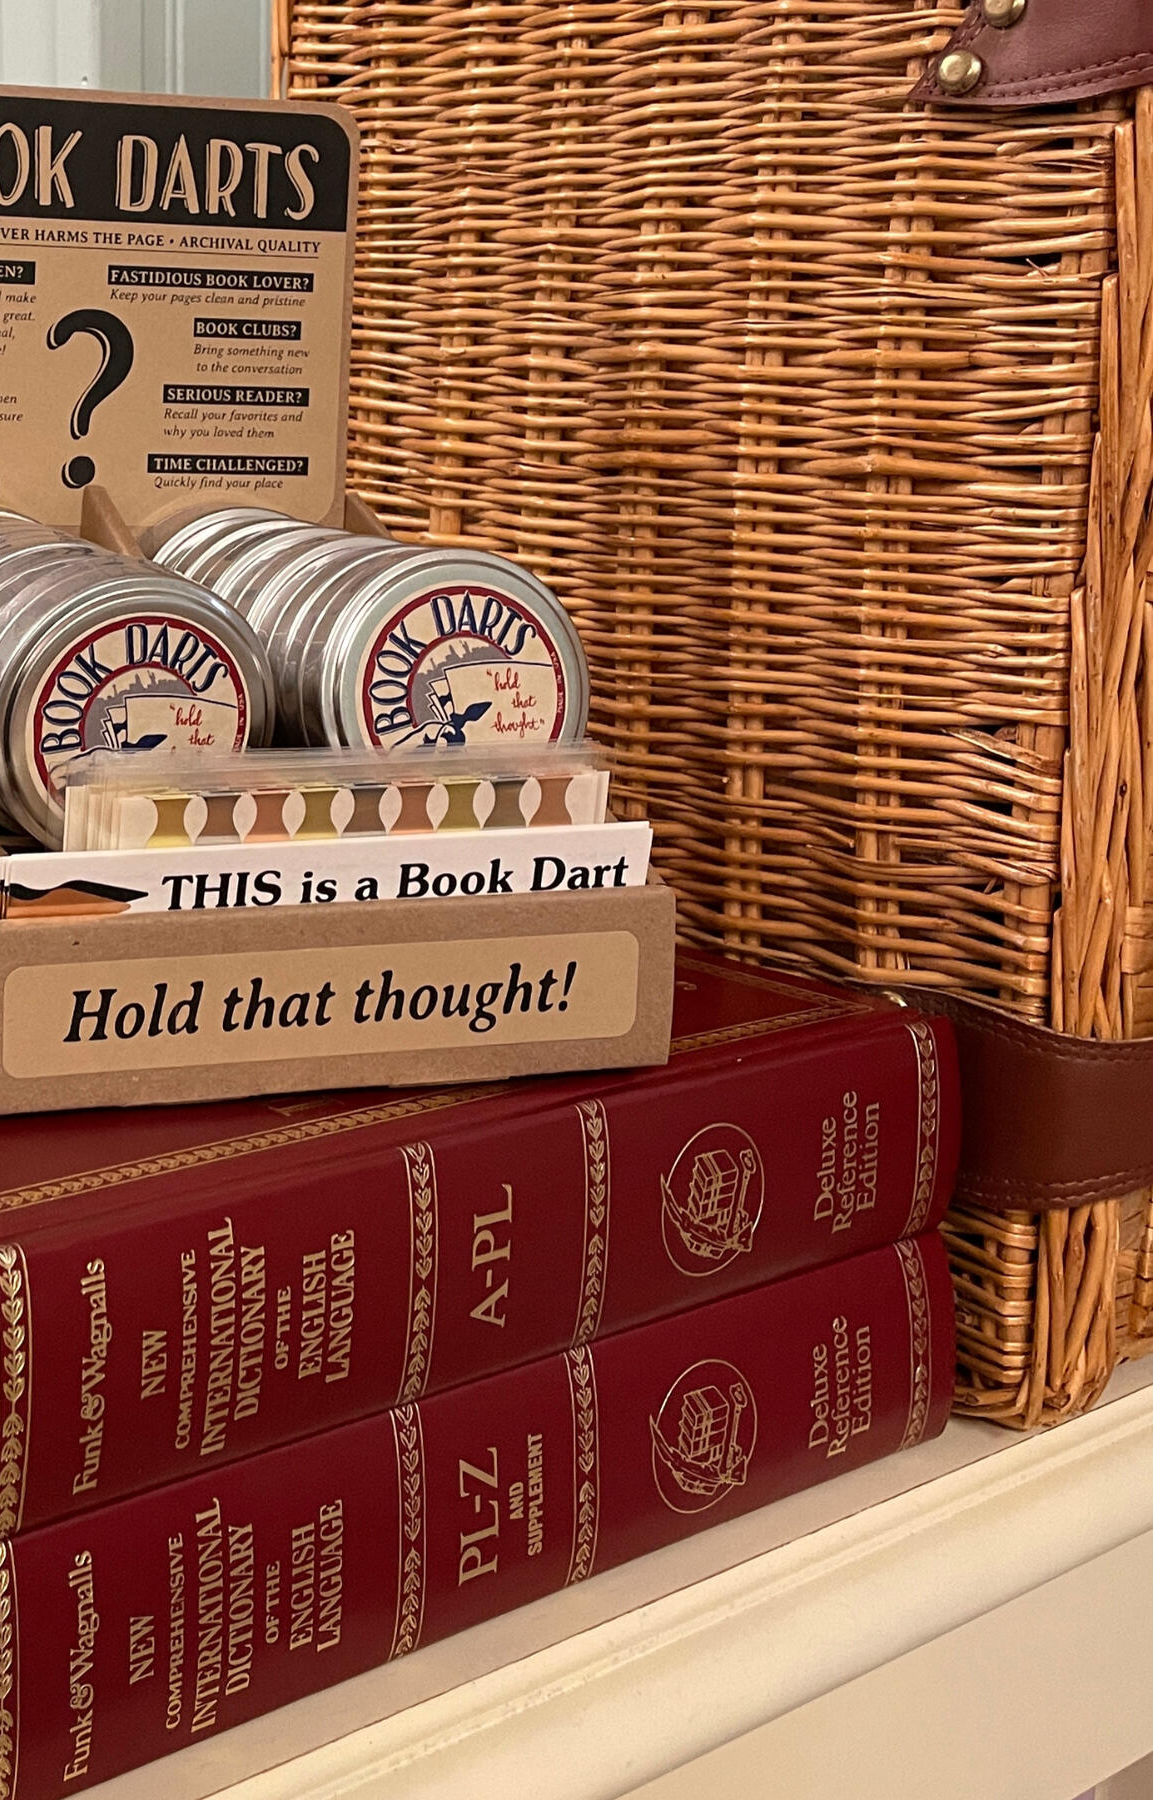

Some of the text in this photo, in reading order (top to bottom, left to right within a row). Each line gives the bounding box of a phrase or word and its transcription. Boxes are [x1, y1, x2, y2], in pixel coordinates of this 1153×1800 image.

[115, 133, 319, 221] DARTS
[34, 228, 88, 244] HARMS
[93, 231, 123, 245] THE
[127, 232, 165, 248] PAGE
[179, 235, 253, 251] ARCHIVAL
[257, 238, 321, 254] QUALITY
[110, 270, 309, 290] FASTIDIOUS BOOK LOVER?
[6, 292, 36, 303] make
[110, 289, 305, 308] Keep your pages clean and pristine
[196, 322, 297, 337] BOOK CLUBS?
[167, 388, 302, 403] SERIOUS READER?
[194, 344, 309, 360] Bring something new
[197, 363, 302, 374] to the conversation
[164, 409, 303, 422] Recall your favorites and
[164, 427, 274, 439] why you loved them
[154, 458, 303, 472] TIME CHALLENGED?
[154, 477, 283, 490] Quickly find your place
[41, 622, 229, 753] BOOK DARTS
[369, 590, 536, 735] BOOK DARTS
[511, 692, 537, 708] that
[189, 731, 215, 746] that
[161, 856, 628, 909] THIS is a Book Dart
[63, 961, 578, 1042] Hold that thought!
[813, 1116, 837, 1221] Deluxe
[831, 1090, 858, 1234] Reference
[856, 1101, 880, 1211] Edition
[470, 1184, 513, 1327] A-PL
[80, 1257, 112, 1394] Wagnalls
[175, 1249, 198, 1449] COMPREHENSIVE
[200, 1216, 236, 1456] INTERNATIONAL
[234, 1246, 265, 1421] DICTIONARY
[274, 1286, 291, 1370] OF THE
[298, 1250, 327, 1379] ENGLISH
[325, 1229, 355, 1383] LANGUAGE
[141, 1330, 167, 1400] NEW
[809, 1343, 831, 1449] Deluxe
[826, 1314, 848, 1458] Reference
[851, 1325, 871, 1436] Edition
[73, 1418, 104, 1495] Funk
[509, 1481, 524, 1520] AND
[527, 1433, 543, 1556] SUPPLEMENT
[458, 1447, 499, 1587] PL-Z
[68, 1550, 100, 1684] Wagnalls
[191, 1497, 223, 1732] INTERNATIONAL
[225, 1523, 254, 1696] DICTIONARY
[265, 1561, 280, 1644] OF THE
[289, 1523, 314, 1651] ENGLISH
[317, 1499, 343, 1653] LANGUAGE
[129, 1615, 154, 1684] NEW
[165, 1532, 184, 1729] COMPREHENSIVE
[63, 1708, 93, 1781] Funk
